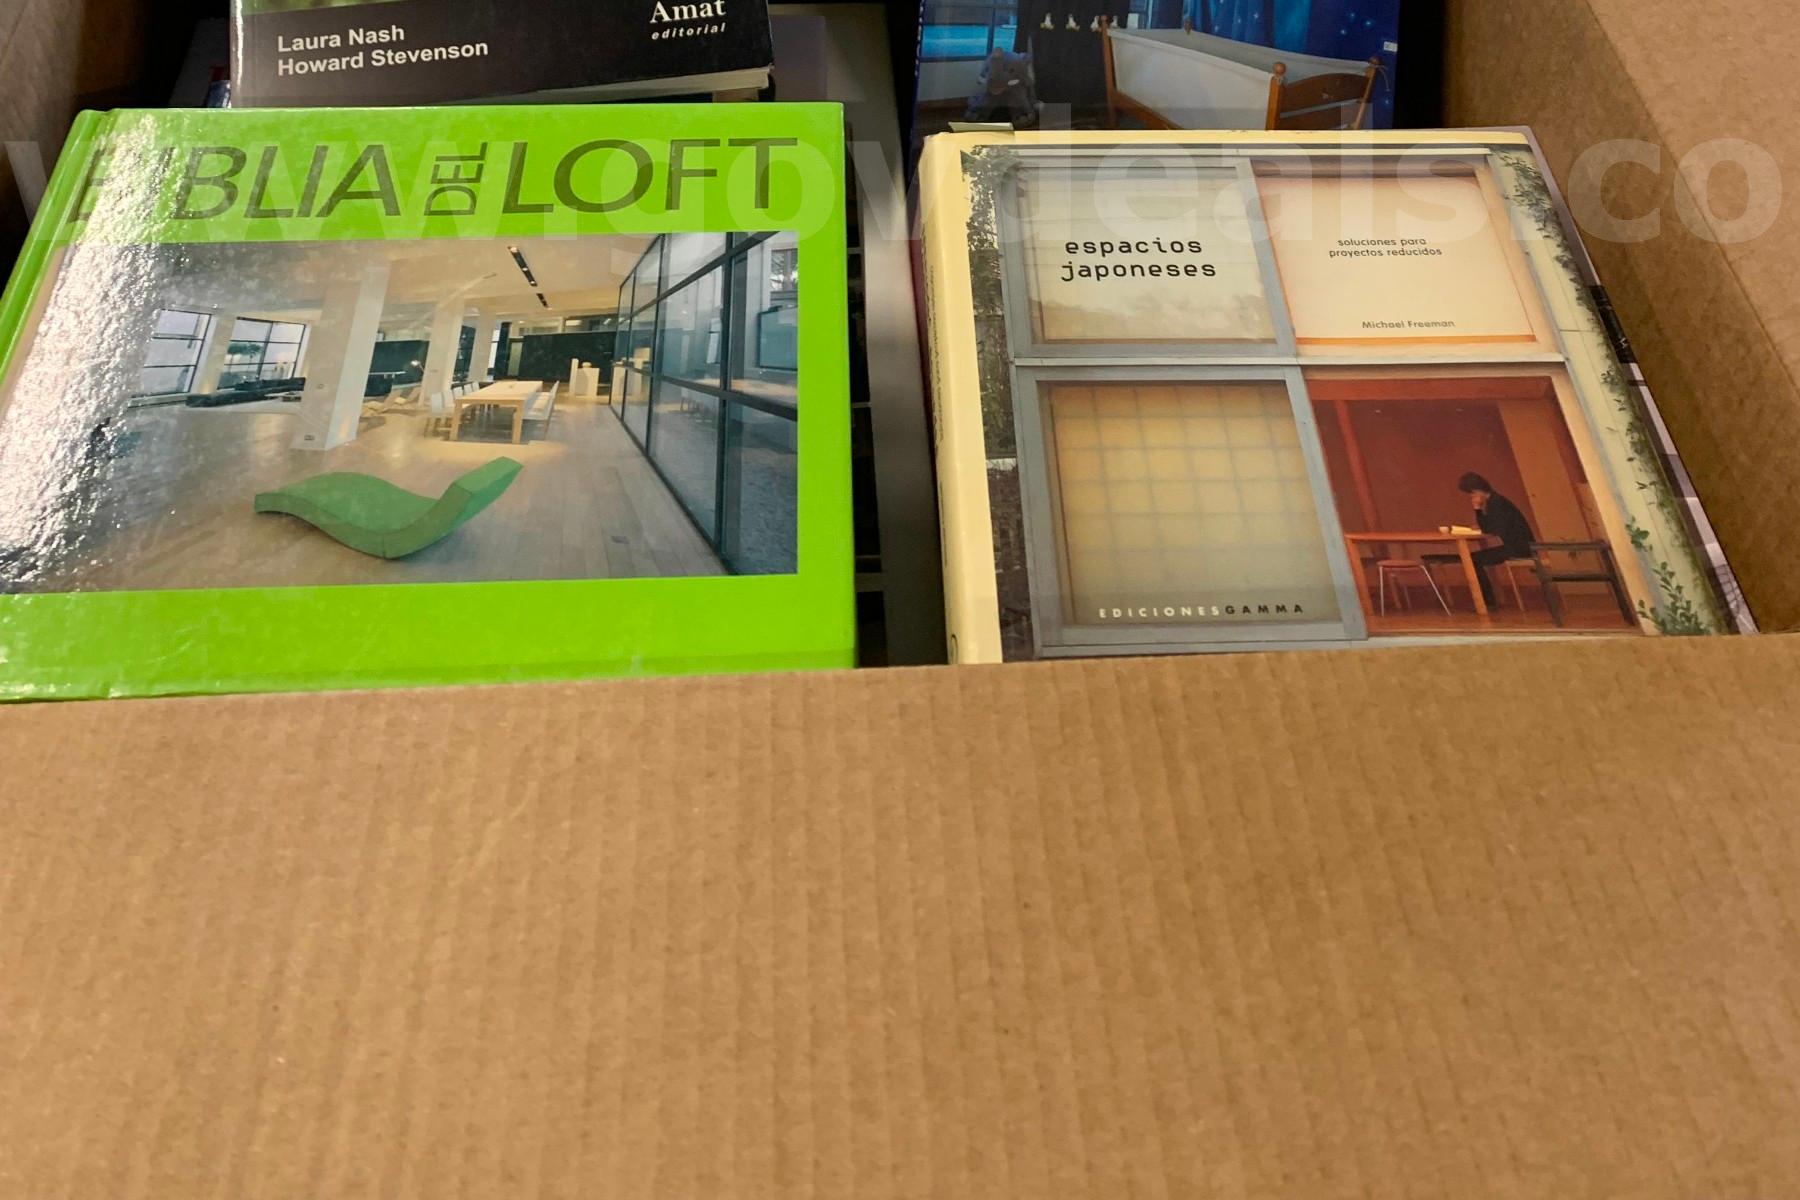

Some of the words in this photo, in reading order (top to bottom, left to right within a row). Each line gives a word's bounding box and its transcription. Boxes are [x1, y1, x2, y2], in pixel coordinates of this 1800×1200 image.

[277, 31, 341, 54] Laura
[349, 24, 406, 47] Nash
[651, 23, 727, 41] editorial
[277, 51, 365, 77] Howard
[370, 39, 489, 68] Stevenson
[423, 141, 489, 217] DEL
[501, 137, 798, 216] LOFT
[1064, 237, 1203, 259] espacios
[1328, 247, 1384, 259] proyectos
[1386, 247, 1443, 257] reducidos
[1337, 237, 1397, 247] soluciones
[1400, 238, 1428, 247] para
[1060, 260, 1217, 283] japoneses
[1361, 320, 1405, 329] Michael
[1407, 319, 1456, 328] Freeman
